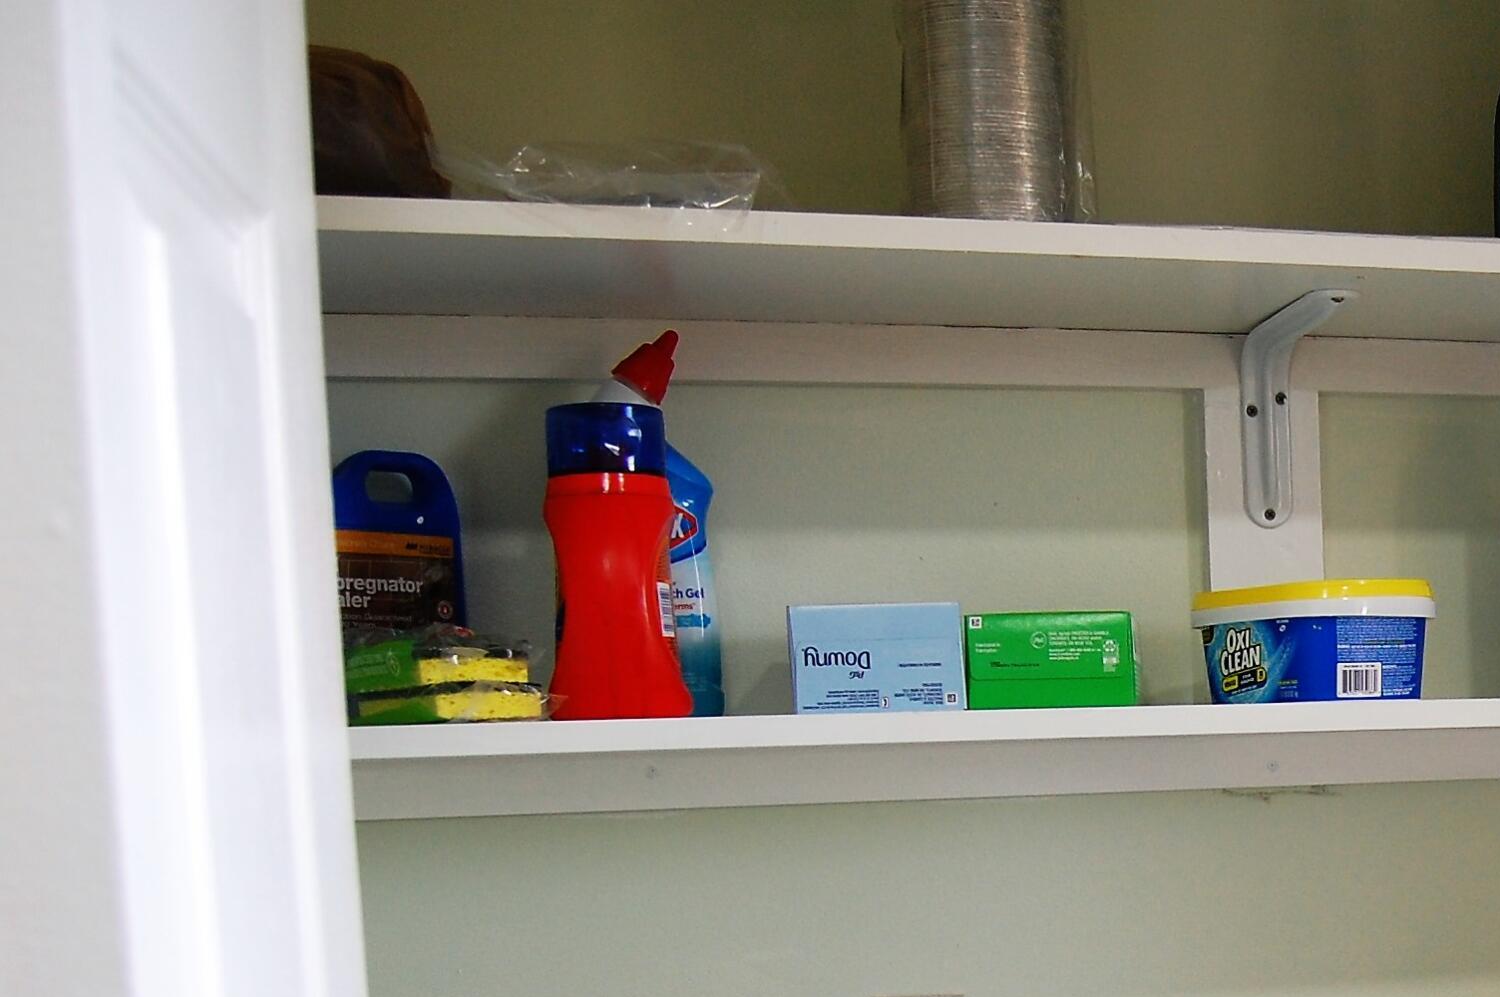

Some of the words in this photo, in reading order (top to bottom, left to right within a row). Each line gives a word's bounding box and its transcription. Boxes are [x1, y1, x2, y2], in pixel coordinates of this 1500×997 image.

[337, 576, 424, 594] pregnator
[1226, 628, 1250, 654] OXI
[802, 647, 871, 670] Downy
[1221, 645, 1261, 676] CLEAN
